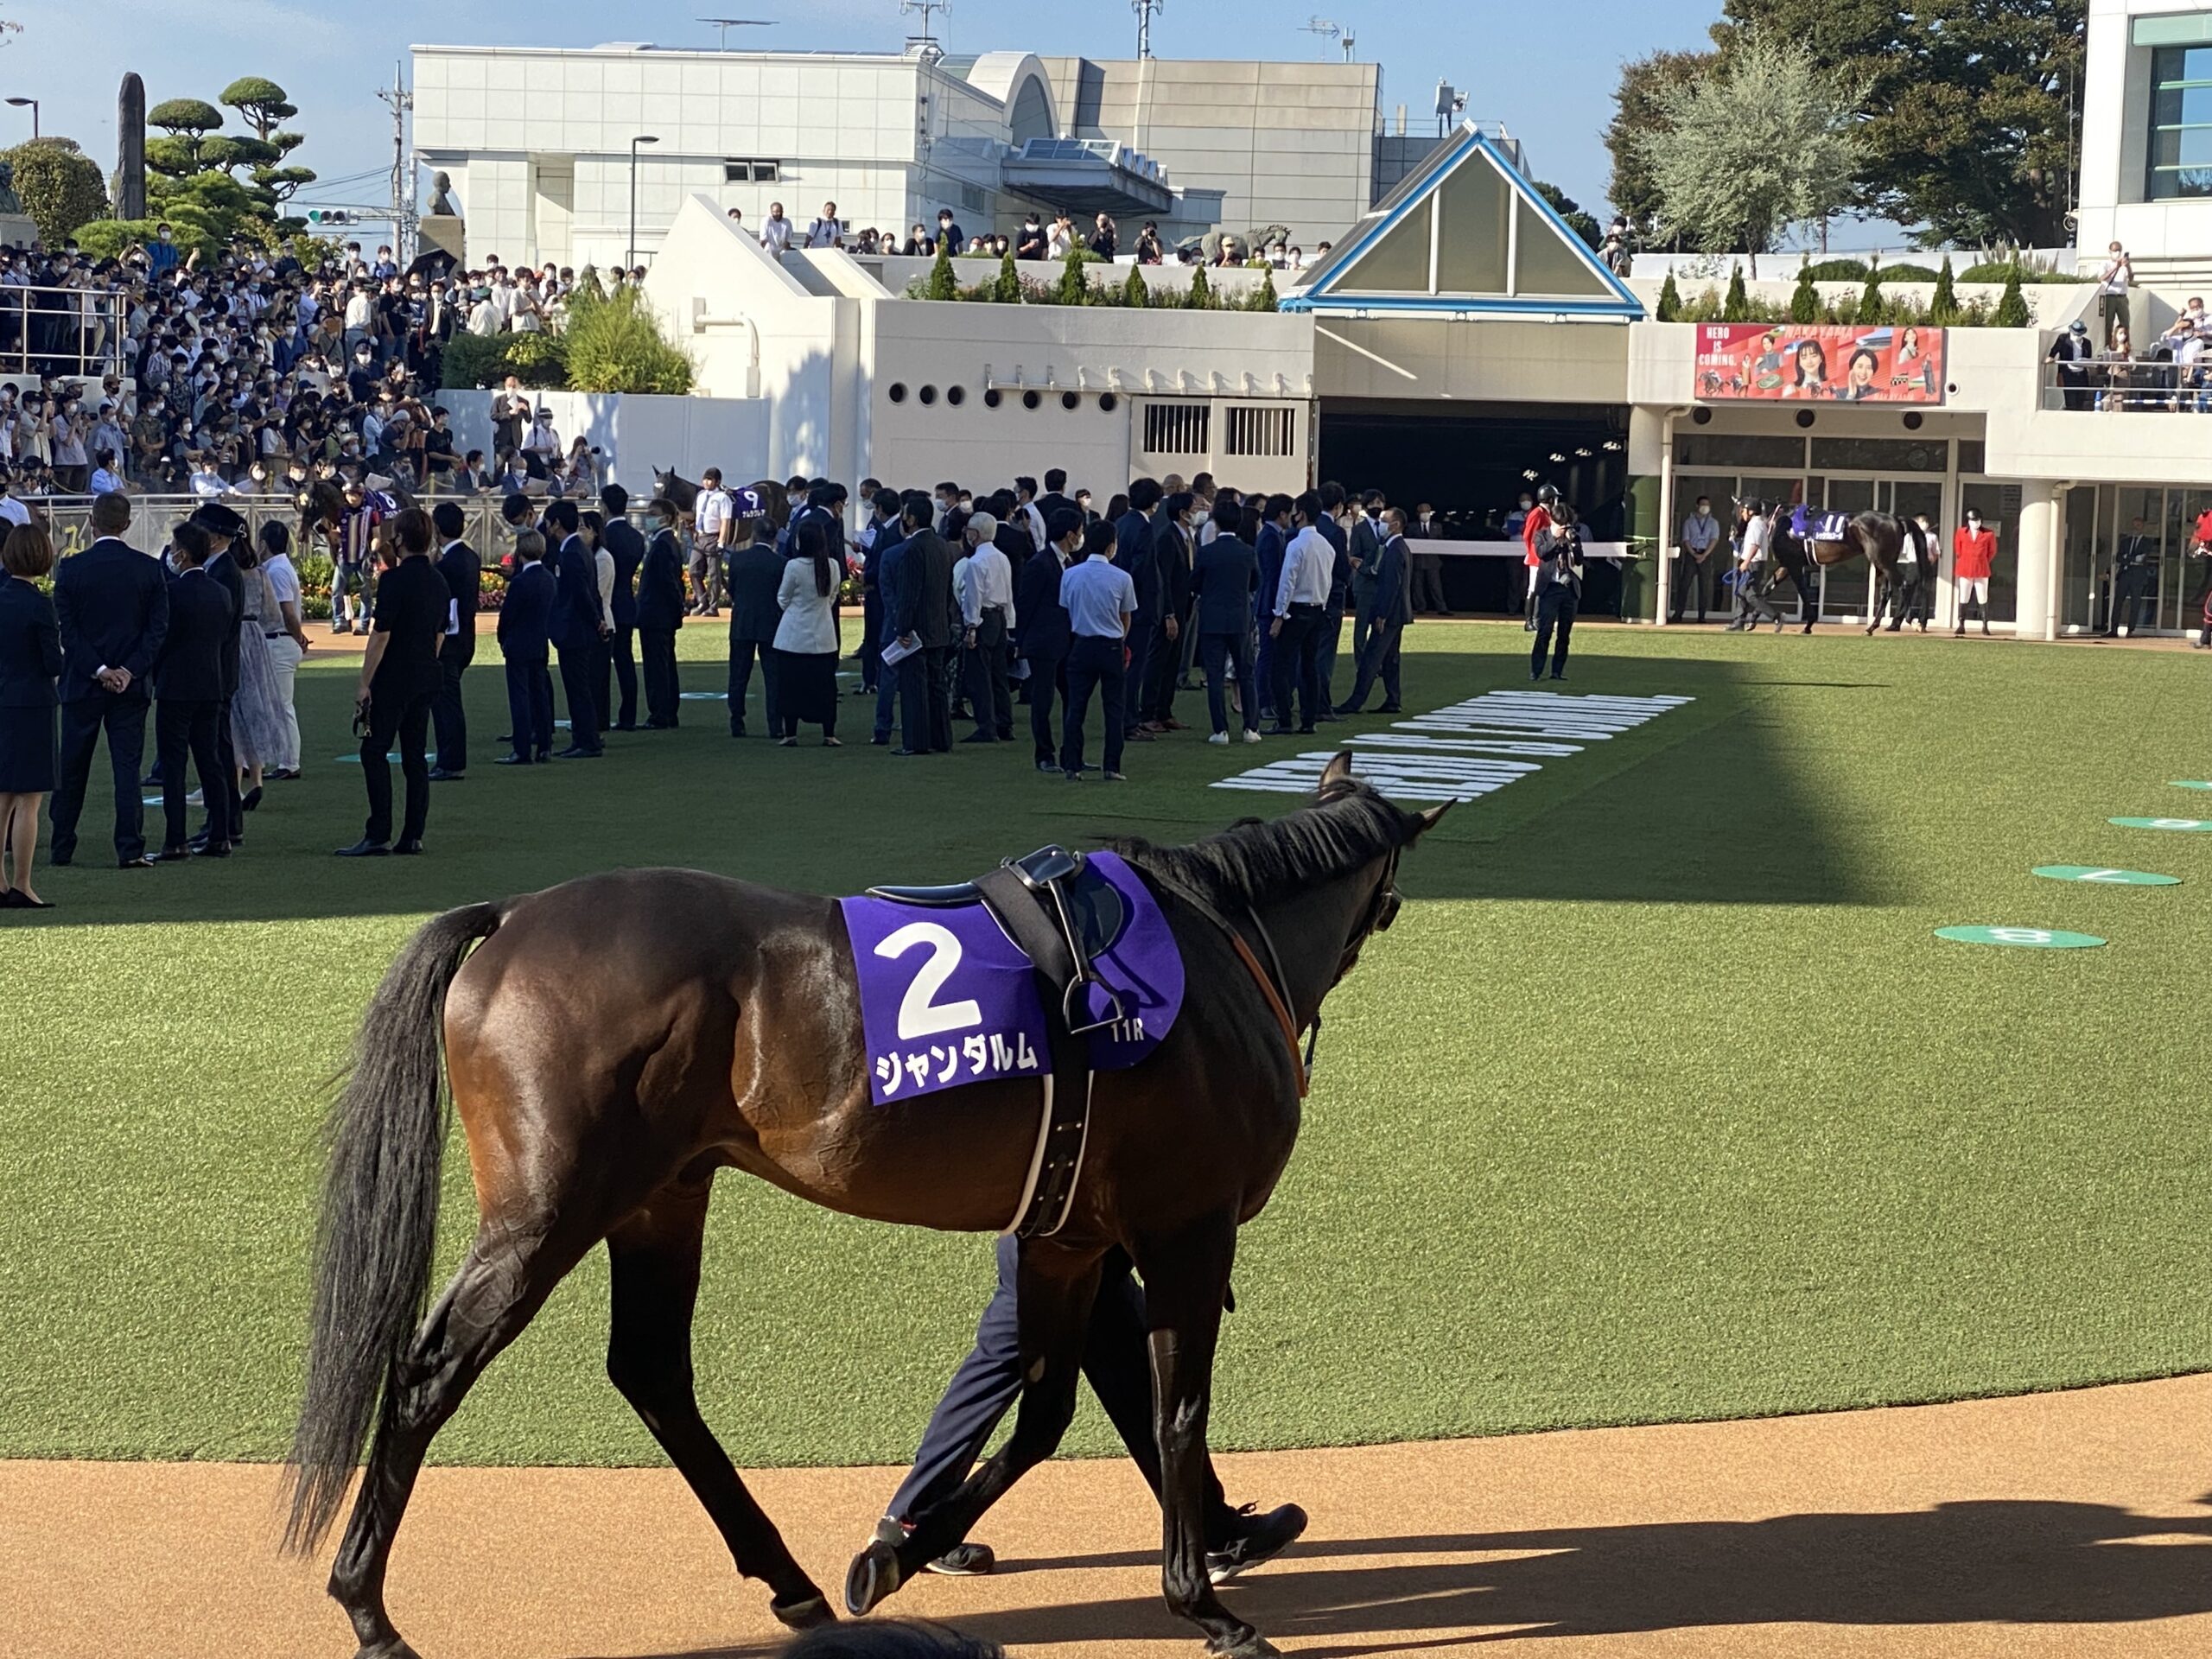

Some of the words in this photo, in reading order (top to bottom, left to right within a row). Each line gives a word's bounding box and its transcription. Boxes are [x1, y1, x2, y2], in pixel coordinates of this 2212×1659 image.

[1707, 327, 1730, 339] HERO
[1713, 341, 1722, 353] IS
[1699, 354, 1737, 365] COMING.
[744, 491, 759, 509] 9
[1825, 514, 1845, 533] 11
[874, 921, 982, 1040] 2
[1110, 1017, 1145, 1043] 11R
[876, 1033, 1039, 1096] ジャンダルム
